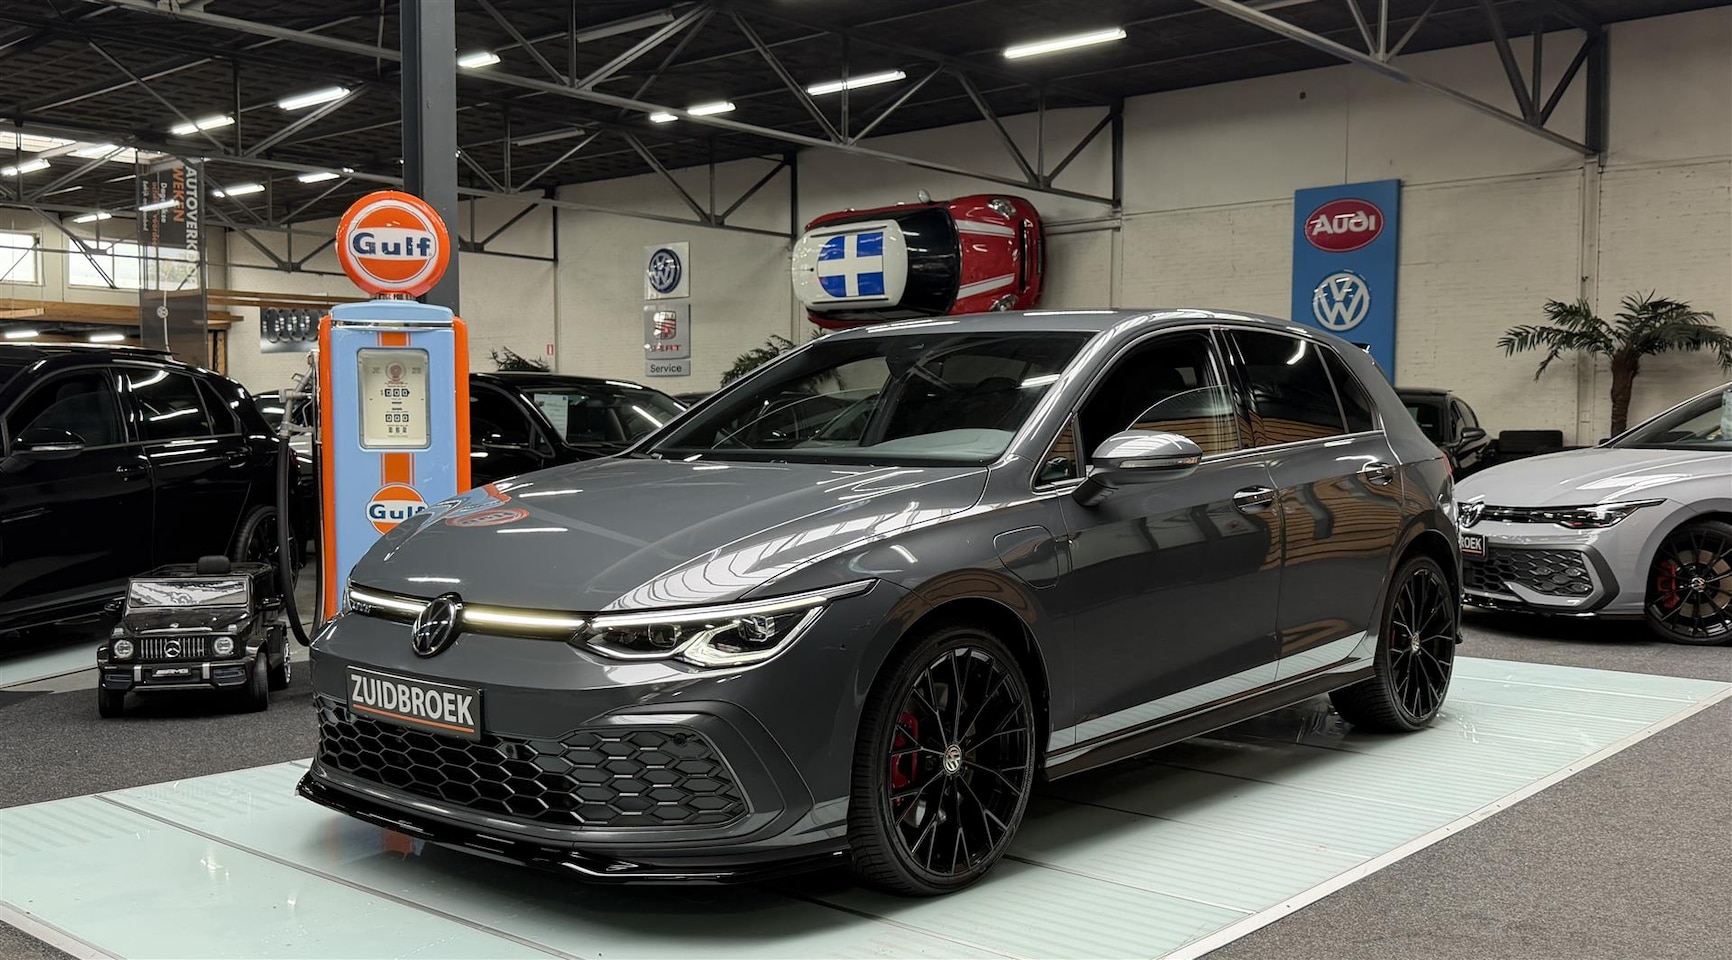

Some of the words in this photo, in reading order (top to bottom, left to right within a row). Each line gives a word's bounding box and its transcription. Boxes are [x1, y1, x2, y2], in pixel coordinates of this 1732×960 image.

[353, 232, 431, 256] Gulf
[650, 363, 682, 373] Service
[350, 674, 475, 726] ZUIDBROEK
